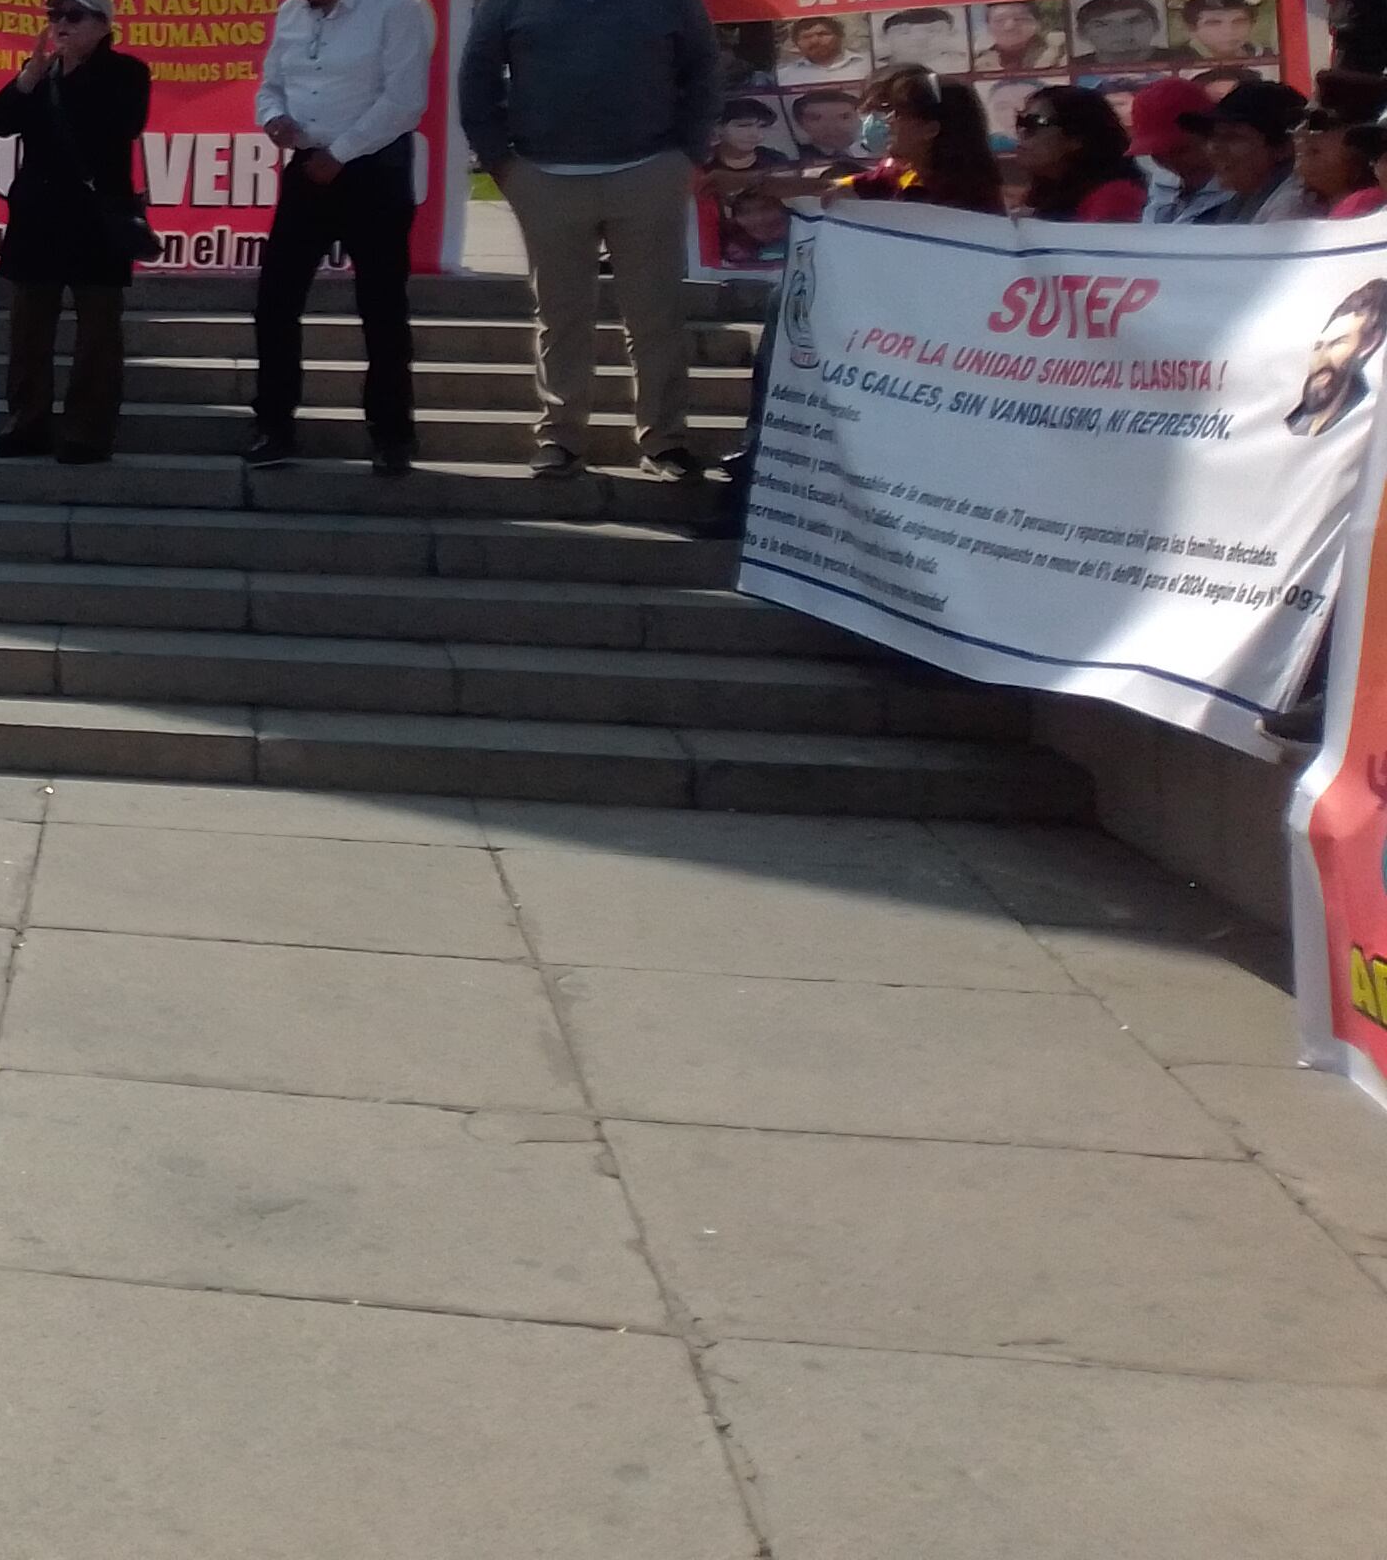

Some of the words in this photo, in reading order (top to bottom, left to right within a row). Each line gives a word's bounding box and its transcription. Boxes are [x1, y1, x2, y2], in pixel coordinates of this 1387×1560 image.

[128, 20, 267, 49] HUMANOS
[149, 60, 222, 82] UMANOS
[225, 59, 259, 82] DEL
[193, 227, 227, 266] el
[988, 274, 1161, 339] SUTEP
[861, 327, 914, 358] POR
[918, 339, 950, 367] LA
[952, 347, 1037, 382] UNIDAD
[1037, 357, 1124, 390] SINDICAL
[1130, 360, 1212, 392] CLASISTA
[820, 358, 856, 388] LAS
[859, 370, 942, 414] CALLES,
[949, 390, 989, 417] SIN
[989, 396, 1104, 436] VANDALISMO,
[1105, 408, 1128, 434] NI
[1127, 408, 1233, 442] REPRESIÓN.
